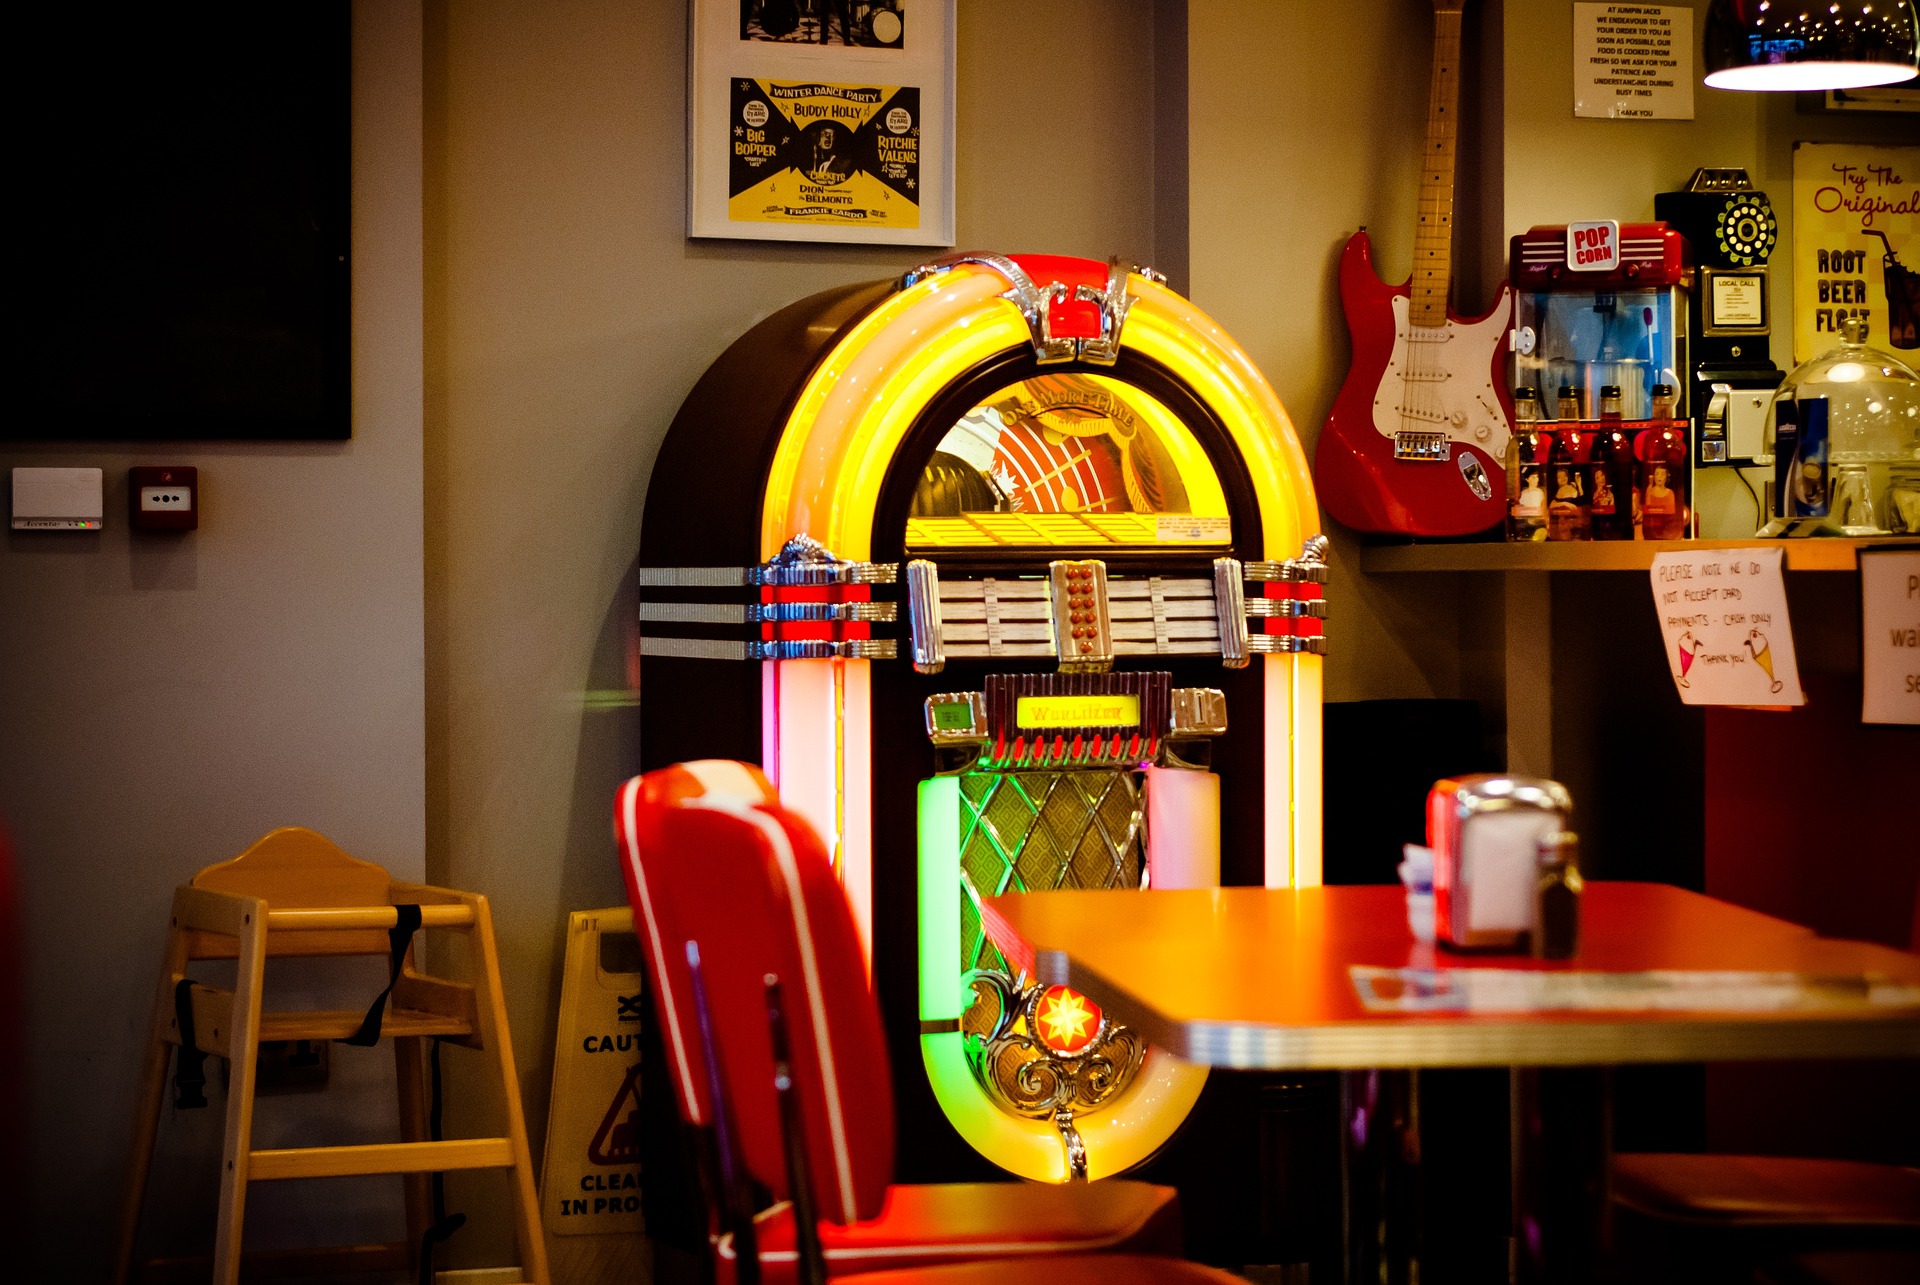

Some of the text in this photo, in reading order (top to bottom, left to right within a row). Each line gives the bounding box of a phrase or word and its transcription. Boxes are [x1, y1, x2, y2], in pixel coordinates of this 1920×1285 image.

[1609, 17, 1648, 25] ENDEAVOUR
[1648, 80, 1674, 88] DURING
[774, 86, 878, 102] WINTER DANCE PARTY
[794, 102, 862, 119] BUDDY HOLLY
[746, 128, 766, 143] BIG
[878, 135, 918, 150] RITCHIE
[735, 142, 776, 156] BOPPER
[878, 148, 916, 164] VALENS
[1832, 163, 1903, 194] Try The
[800, 184, 824, 194] DION
[806, 194, 853, 204] BELMONTS
[1814, 186, 1920, 227] Original
[1574, 226, 1610, 250] POP
[1576, 246, 1612, 264] CORN
[1818, 248, 1866, 274] ROOT
[1818, 278, 1866, 304] BEER
[1002, 390, 1135, 426] ONE MORE TIME
[1660, 562, 1761, 582] PLEASE NOTE WE DO
[1663, 590, 1678, 605] NOT
[1684, 588, 1718, 602] ACCEPT
[1724, 614, 1747, 626] CASH
[1751, 613, 1772, 628] ONLY
[1700, 654, 1730, 666] THANK
[581, 1173, 641, 1192] CLEA
[561, 1196, 641, 1216] IN PRO
